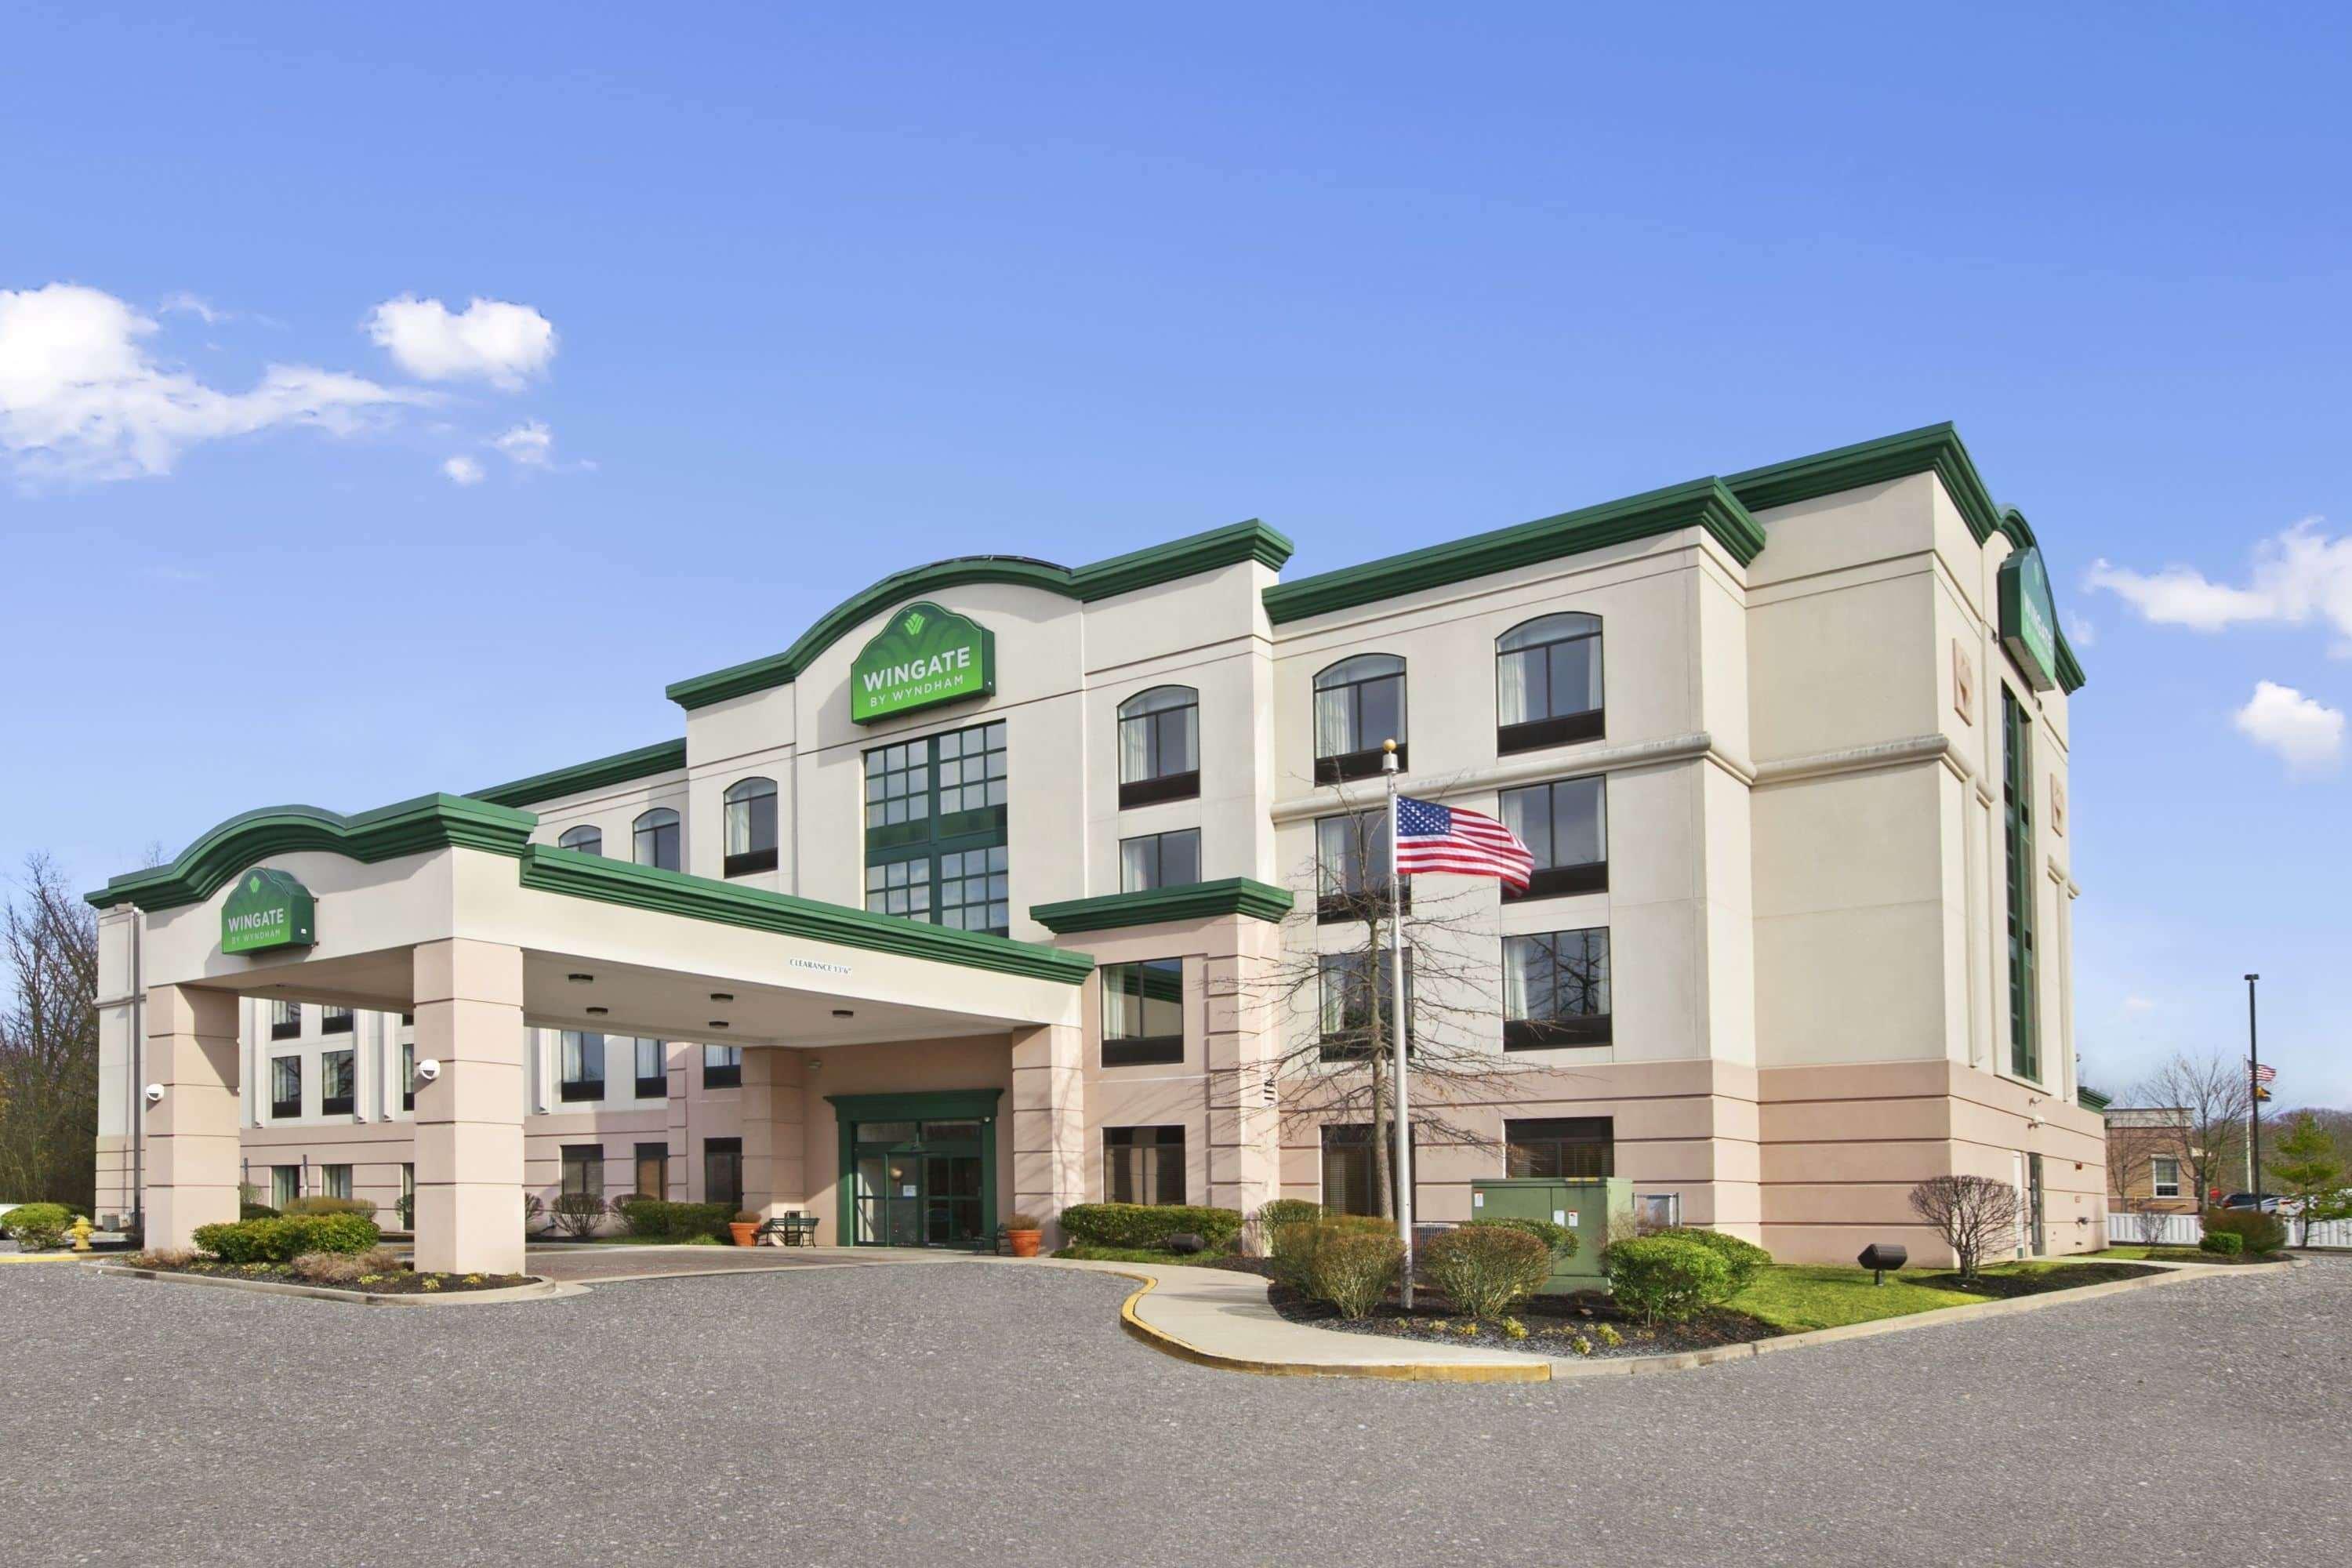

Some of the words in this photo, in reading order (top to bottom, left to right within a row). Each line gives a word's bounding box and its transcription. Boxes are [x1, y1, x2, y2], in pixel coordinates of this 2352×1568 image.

[863, 646, 970, 692] WINGATE
[870, 694, 887, 707] BY
[892, 675, 964, 701] WYNDHAM
[228, 908, 284, 933] WINGATE
[231, 935, 240, 945] BY
[244, 928, 281, 942] WYNDHAM
[789, 959, 832, 971] CLEARANCE
